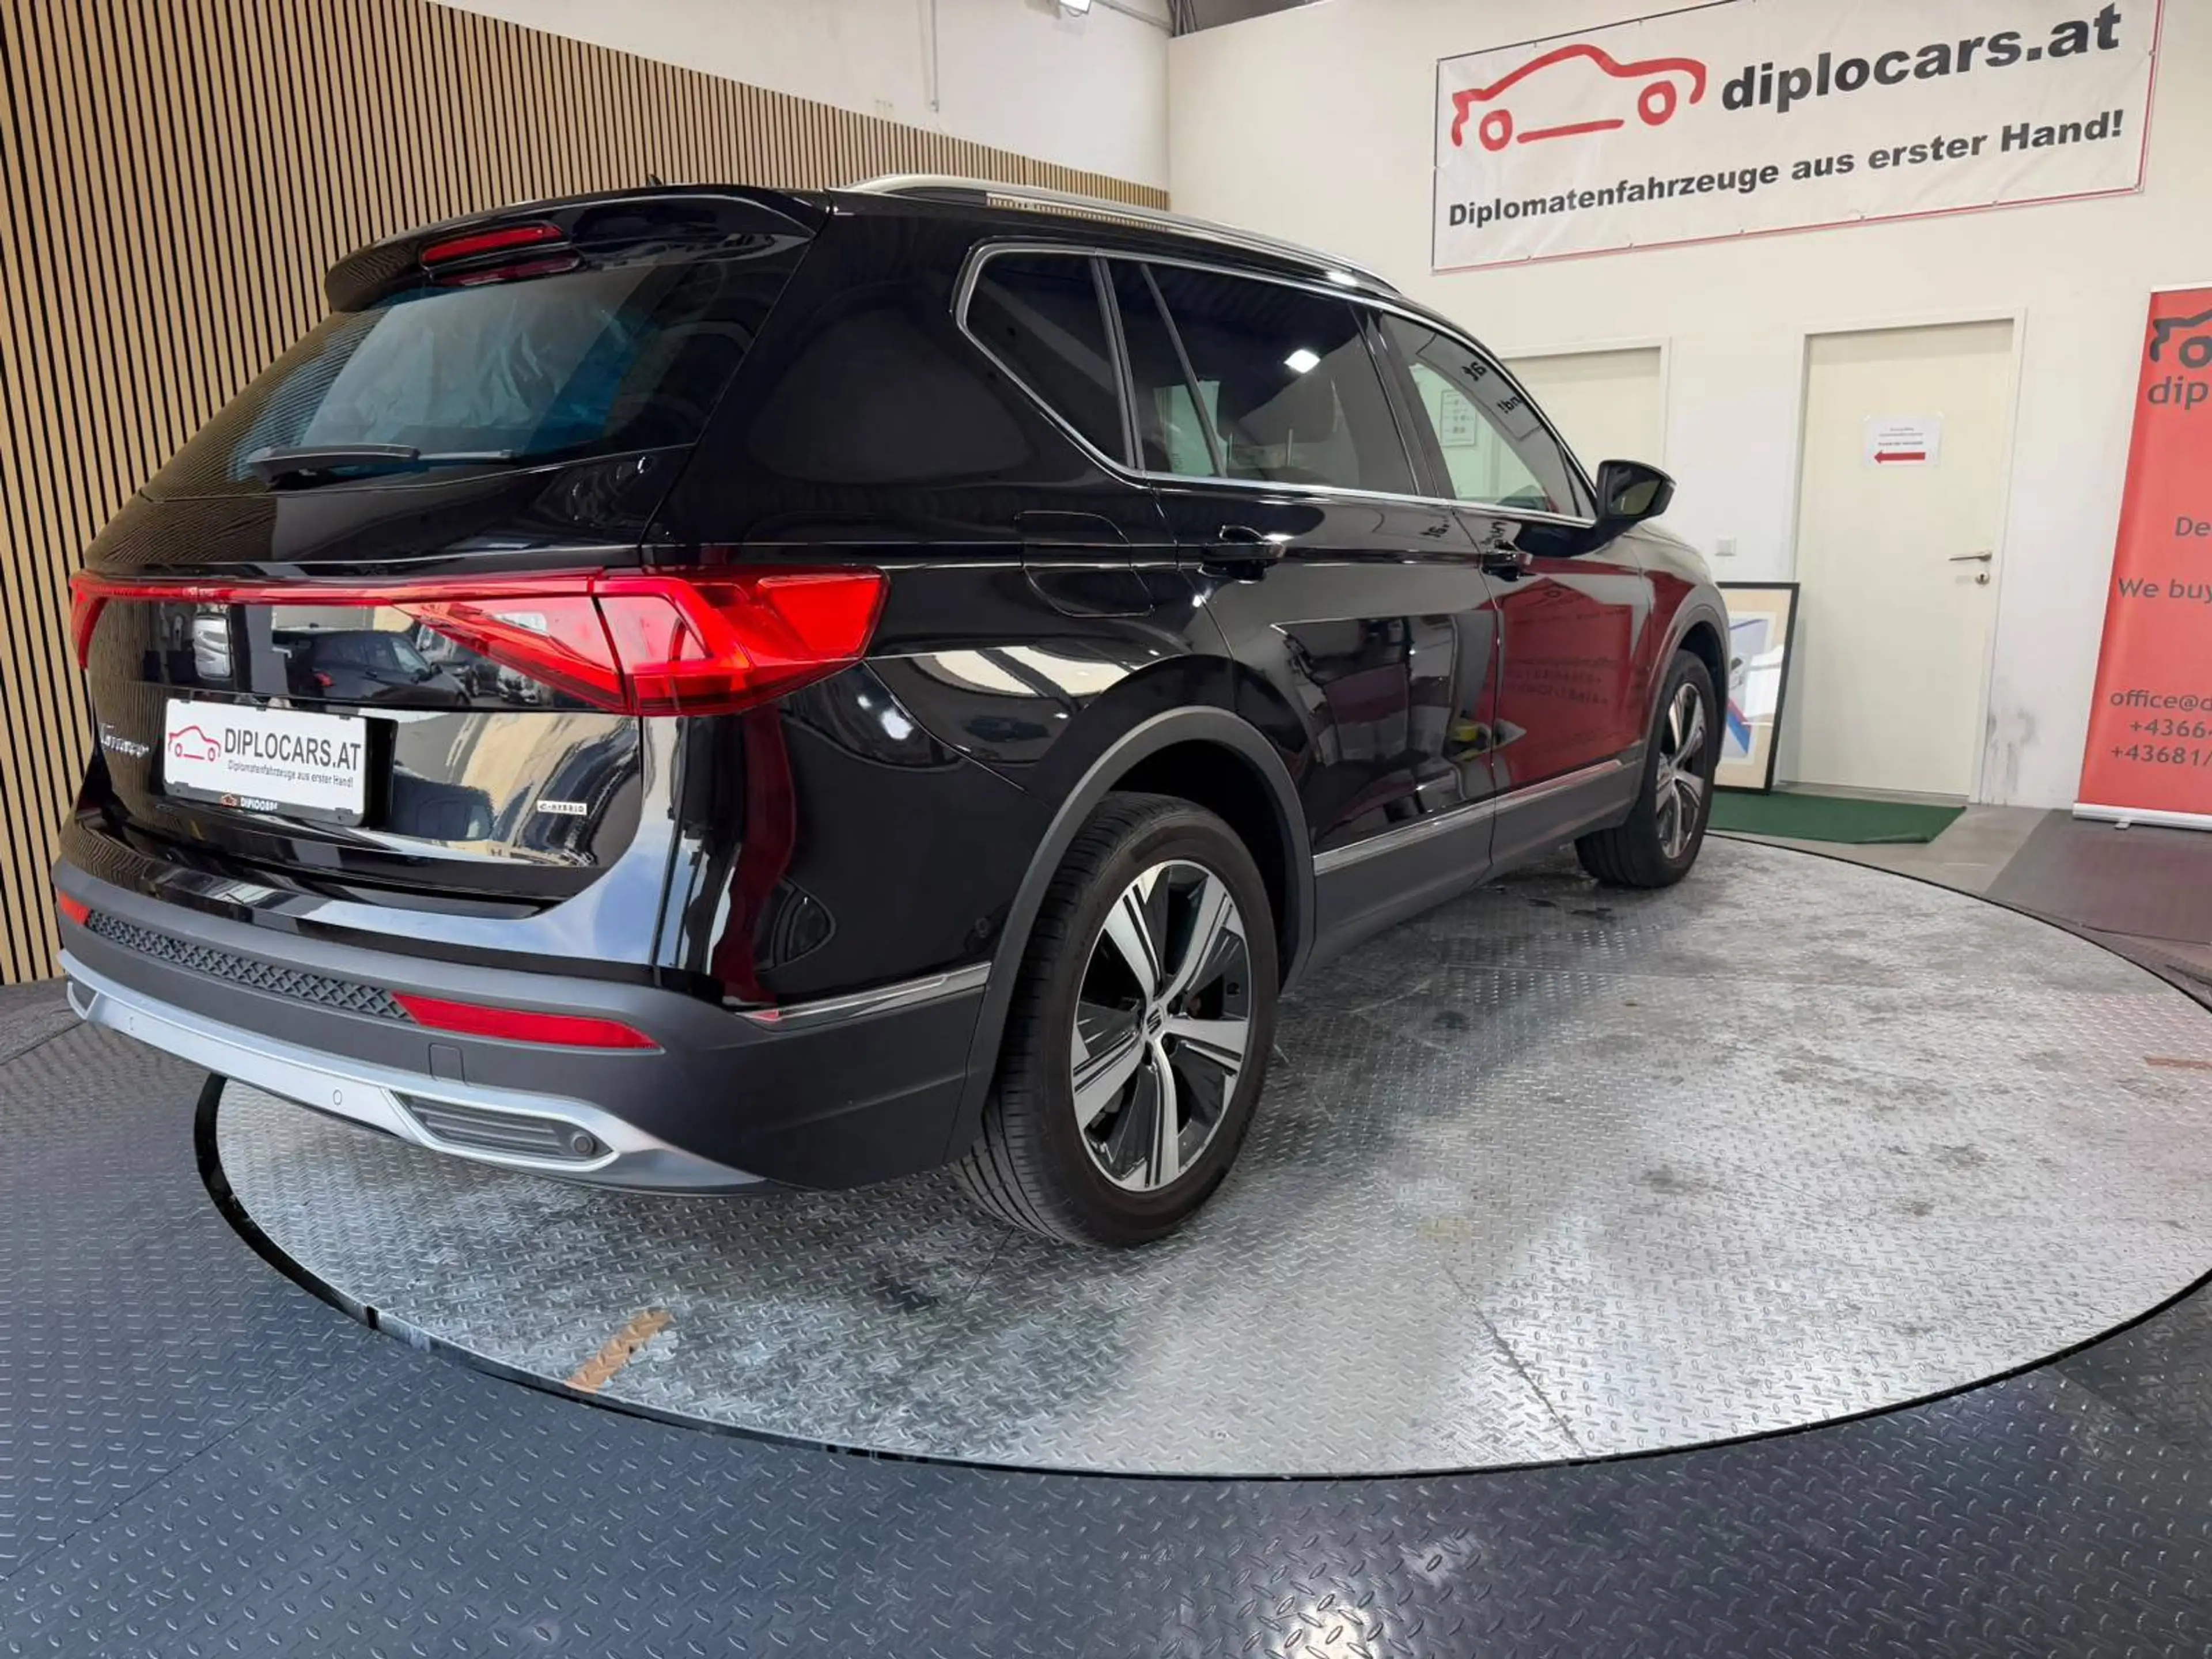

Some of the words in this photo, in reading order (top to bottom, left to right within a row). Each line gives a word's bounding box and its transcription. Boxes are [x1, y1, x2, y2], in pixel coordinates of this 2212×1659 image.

[1722, 3, 2122, 113] diplocars.at
[1449, 164, 1779, 228] Diplomatenfahrzeuge
[1791, 153, 1855, 180] aus
[1868, 133, 1988, 169] erster
[2001, 109, 2123, 152] Hand!
[2147, 376, 2209, 410] dip
[2175, 516, 2211, 537] De
[2119, 577, 2159, 598] We
[2169, 578, 2212, 604] buy
[2129, 718, 2212, 738] +4366
[224, 728, 361, 771] DIPLOCARS.AT
[297, 771, 310, 782] aus
[311, 772, 332, 785] erster
